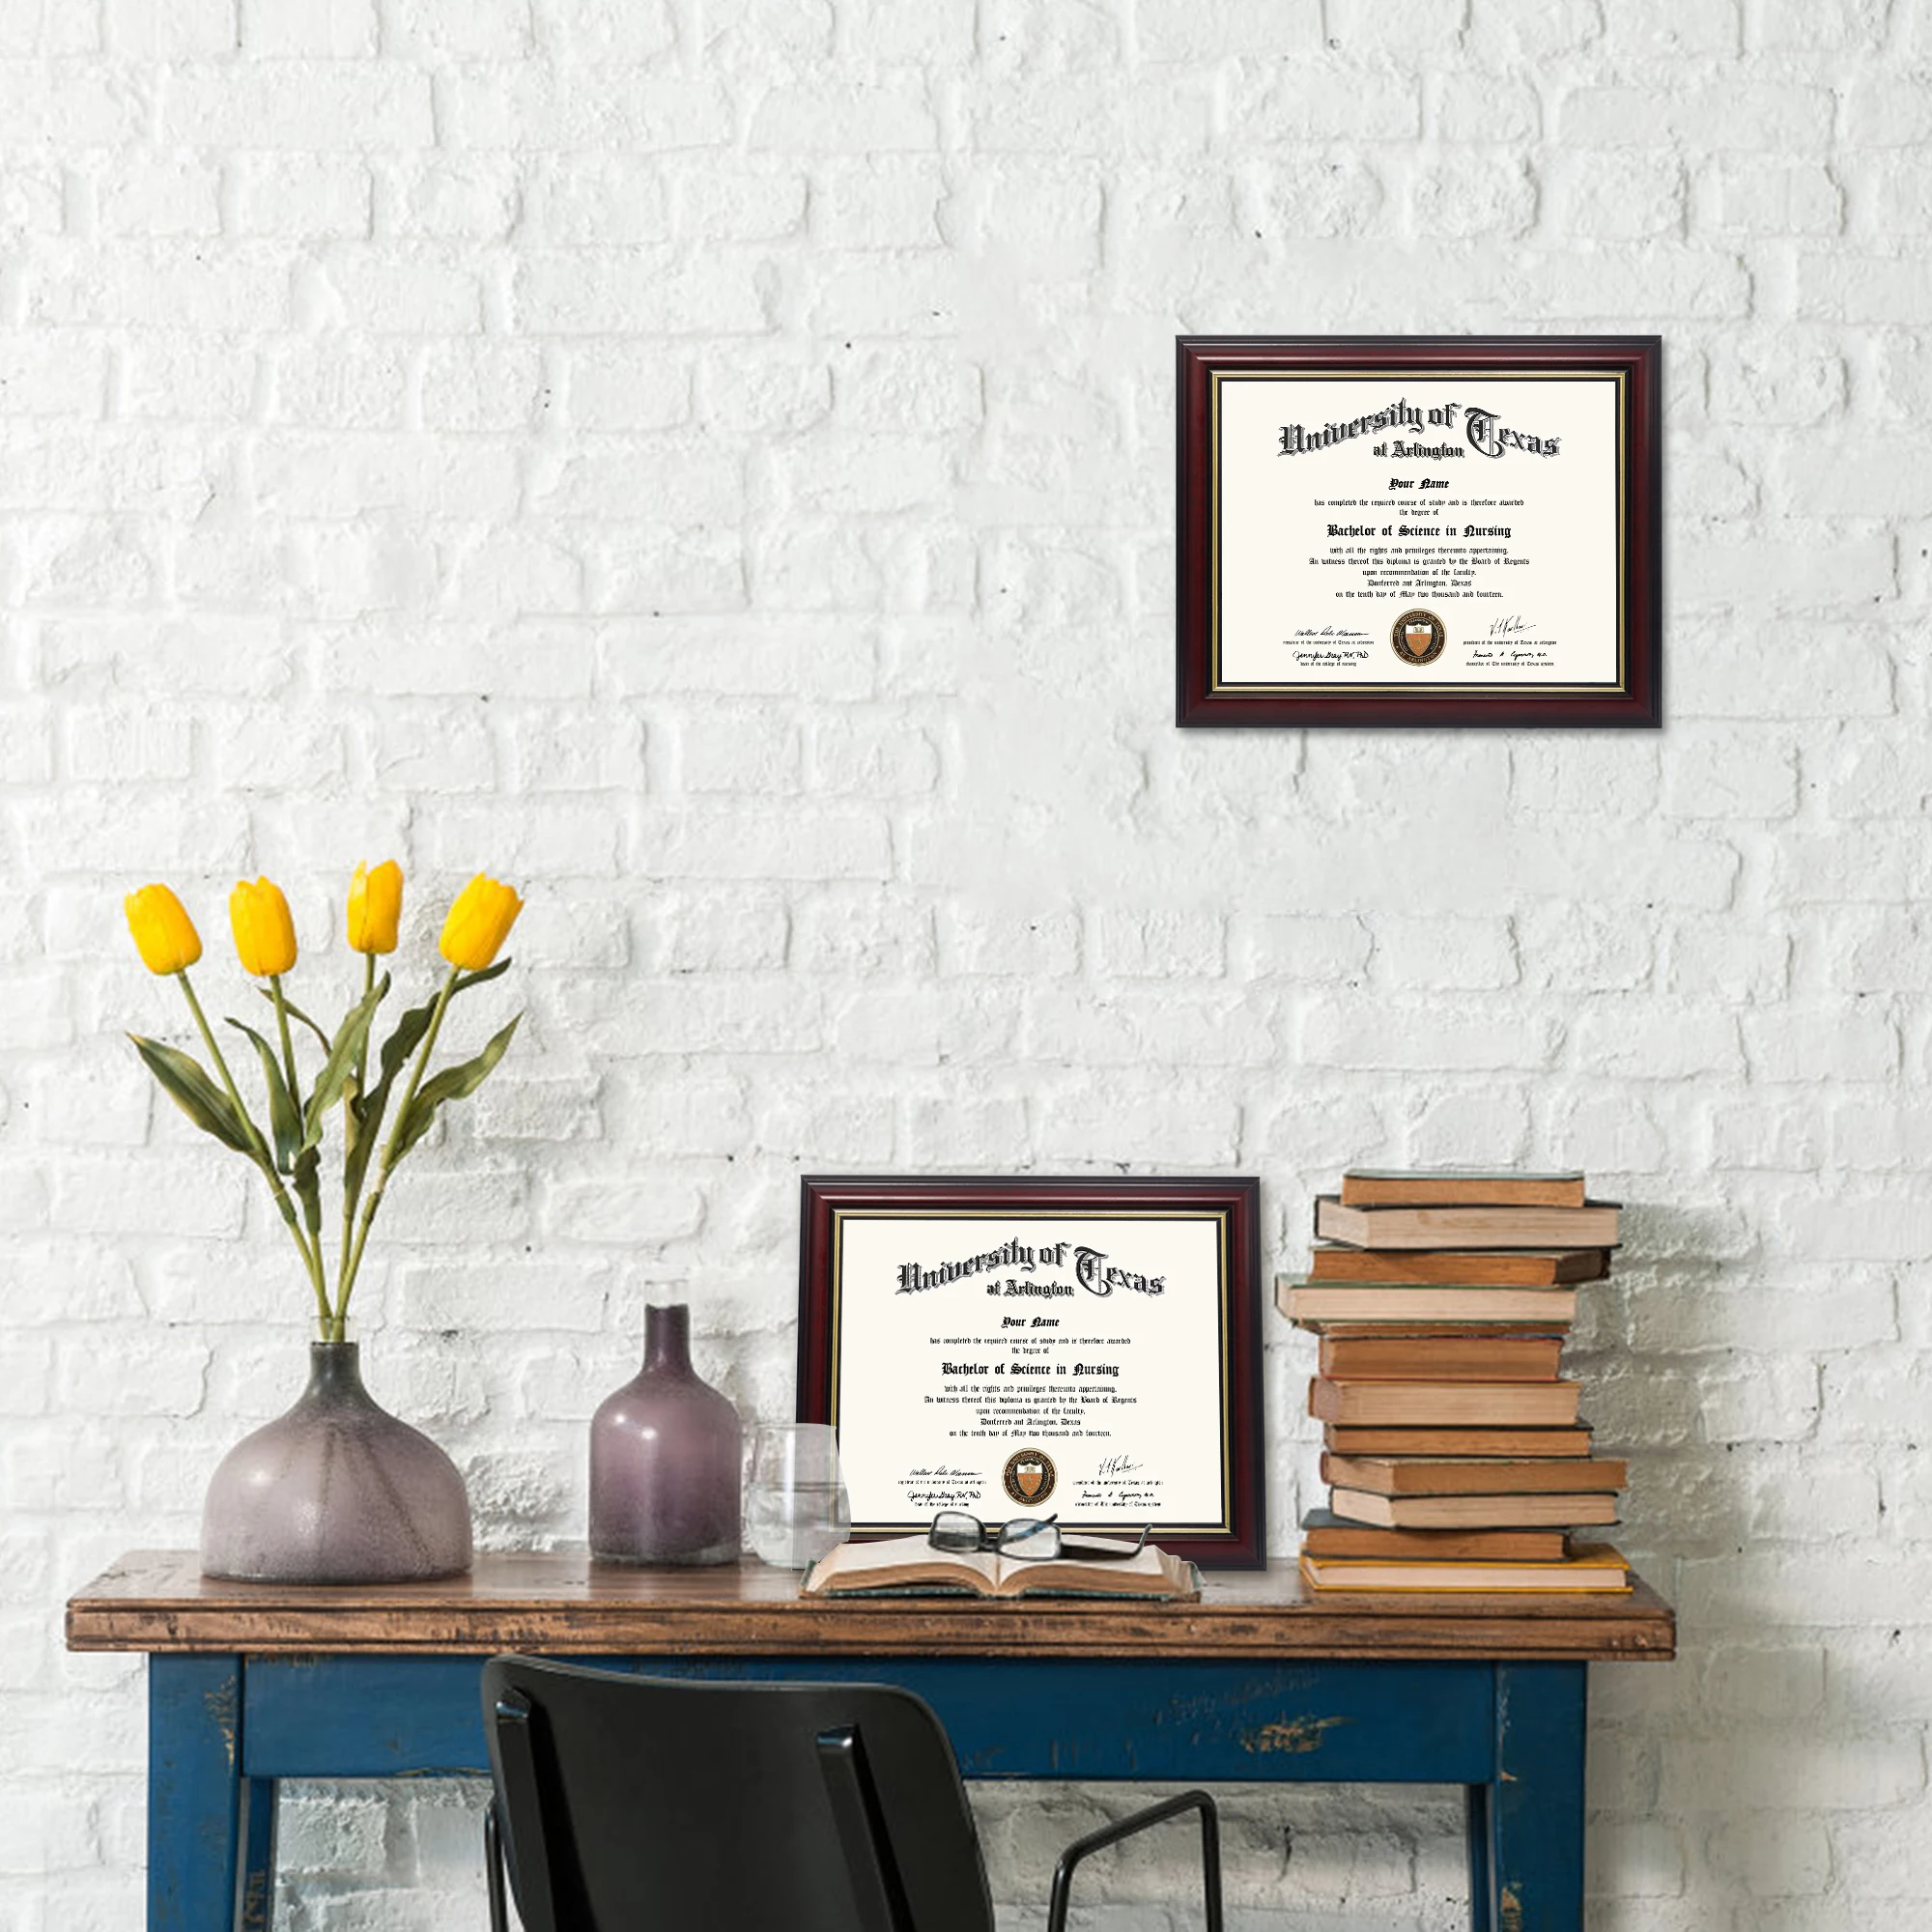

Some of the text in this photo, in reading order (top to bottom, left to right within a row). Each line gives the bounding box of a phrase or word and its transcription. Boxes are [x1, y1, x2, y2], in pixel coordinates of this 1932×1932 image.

[1276, 397, 1562, 459] University of Texas
[1373, 440, 1465, 461] at Arlington
[1388, 478, 1449, 490] Your Name
[1327, 525, 1511, 538] Bachelor of Science in Nursing
[895, 1236, 1167, 1298] University of Texas
[986, 1279, 1075, 1299] at Arlington
[1001, 1317, 1060, 1328] Your Name
[942, 1362, 1120, 1377] Bachelor of Science in Nursing
